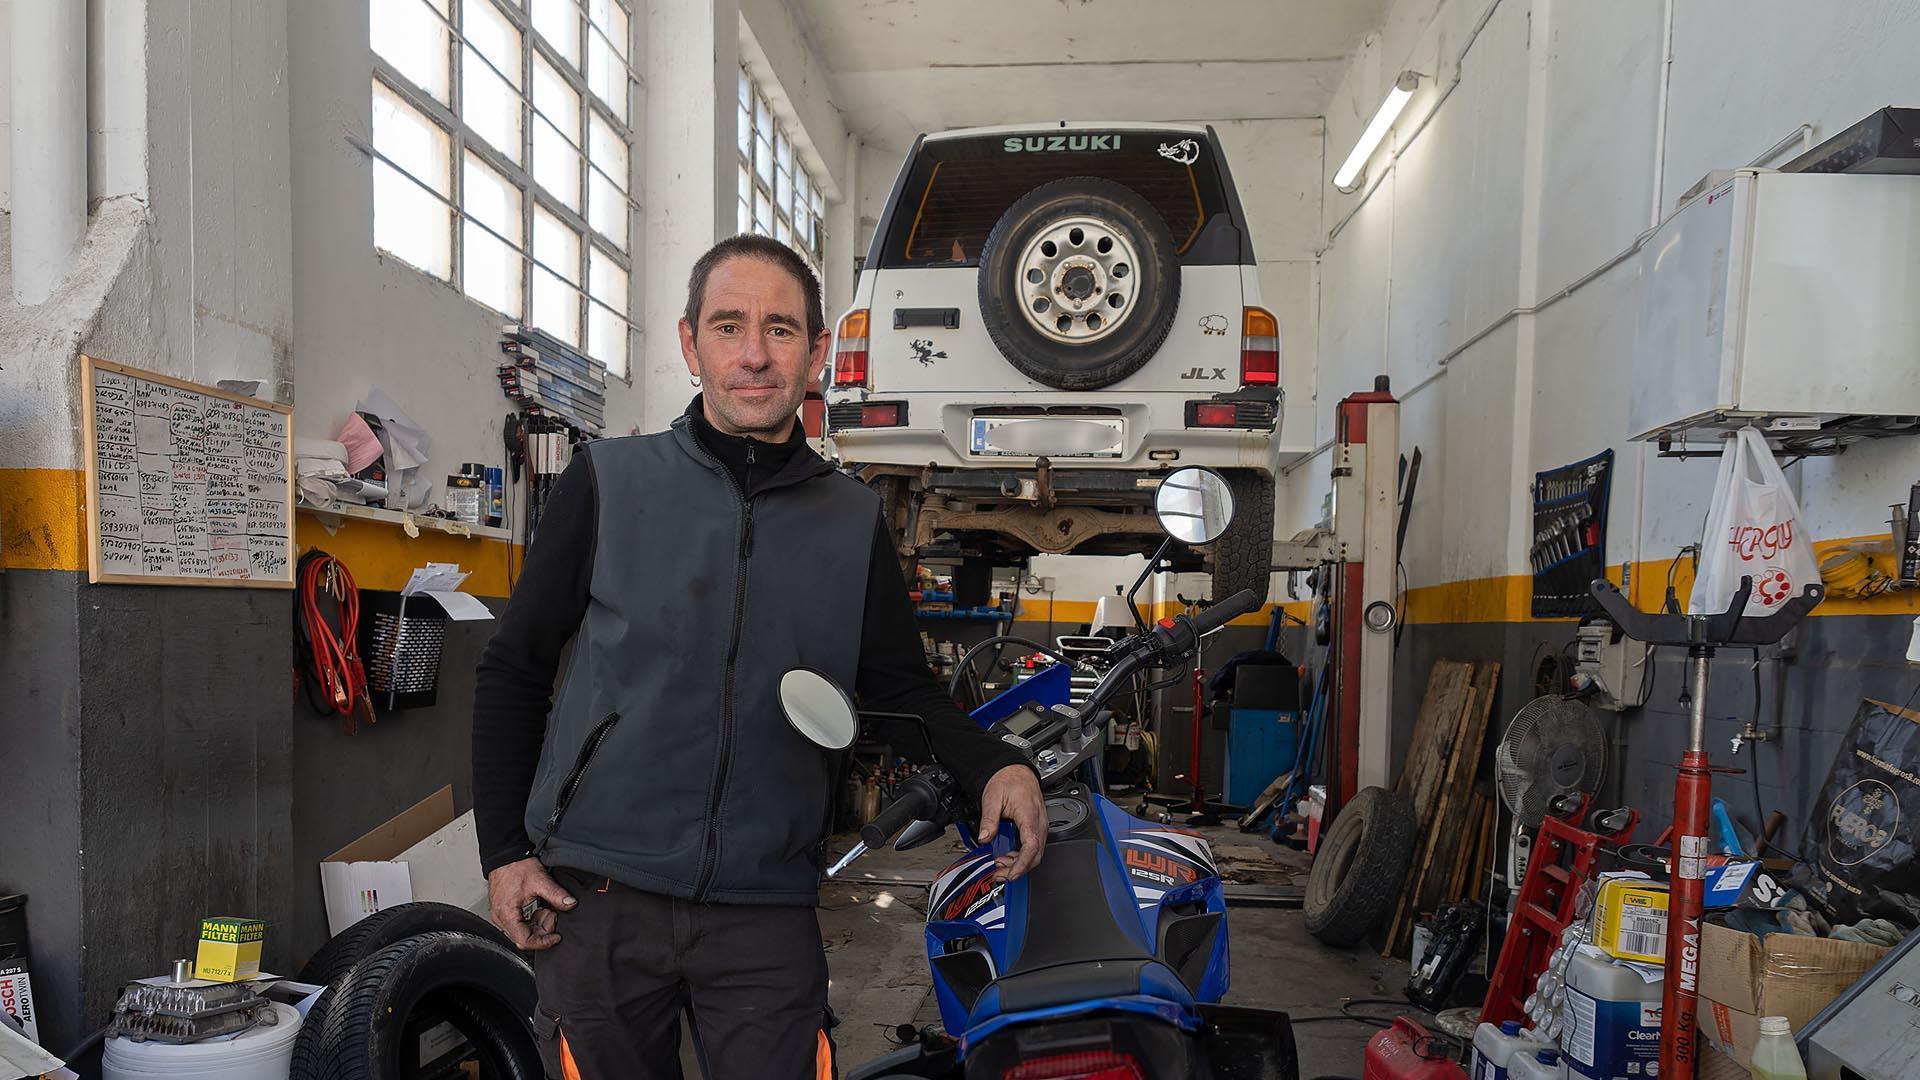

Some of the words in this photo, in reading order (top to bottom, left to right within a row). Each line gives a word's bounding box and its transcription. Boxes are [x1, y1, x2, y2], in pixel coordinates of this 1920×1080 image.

[1004, 135, 1121, 152] SUZUKI
[1181, 367, 1226, 380] JLX
[1131, 868, 1176, 886] 125R
[201, 930, 237, 942] FILTER
[202, 921, 238, 934] MANN
[240, 924, 264, 934] MANN
[239, 931, 264, 942] FILTER
[1679, 933, 1701, 993] MEGA
[1, 979, 17, 1018] OSCH
[18, 976, 33, 1023] AEROTWIN
[1677, 1037, 1688, 1065] 300
